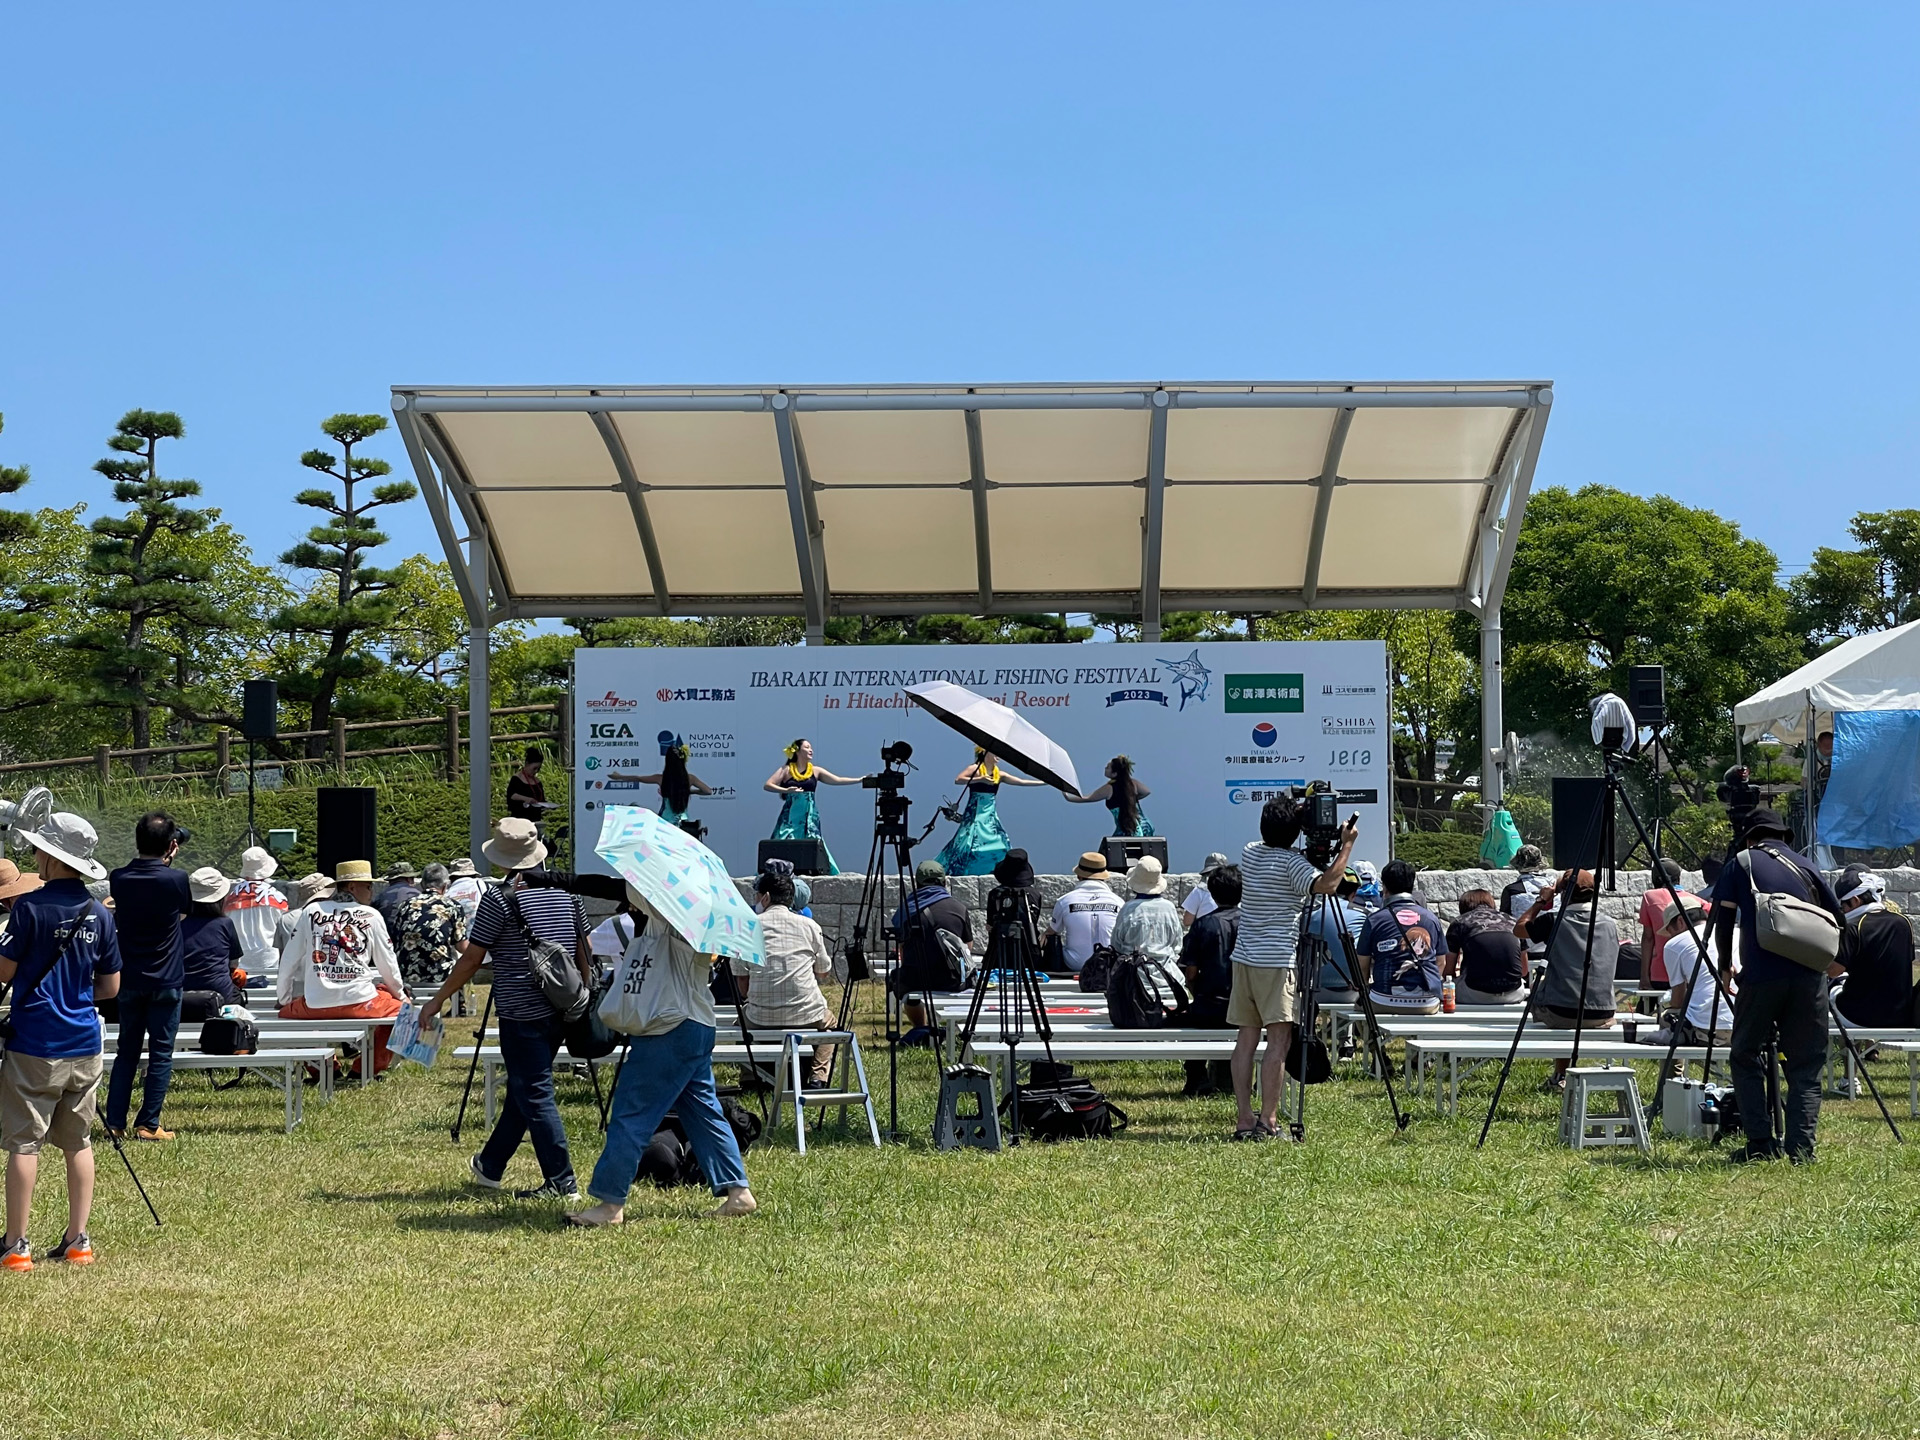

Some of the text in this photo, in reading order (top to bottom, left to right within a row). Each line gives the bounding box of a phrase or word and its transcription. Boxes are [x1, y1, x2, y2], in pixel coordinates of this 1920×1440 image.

[749, 667, 1162, 687] IBARAKI INTERNATIONAL FISHING FESTIVAL
[823, 694, 840, 709] in
[1012, 690, 1070, 707] Resort
[1123, 690, 1150, 699] 2023
[1336, 717, 1375, 727] SHIBA
[590, 723, 634, 739] IGA
[689, 733, 735, 741] NUMATA
[331, 966, 342, 974] AIR
